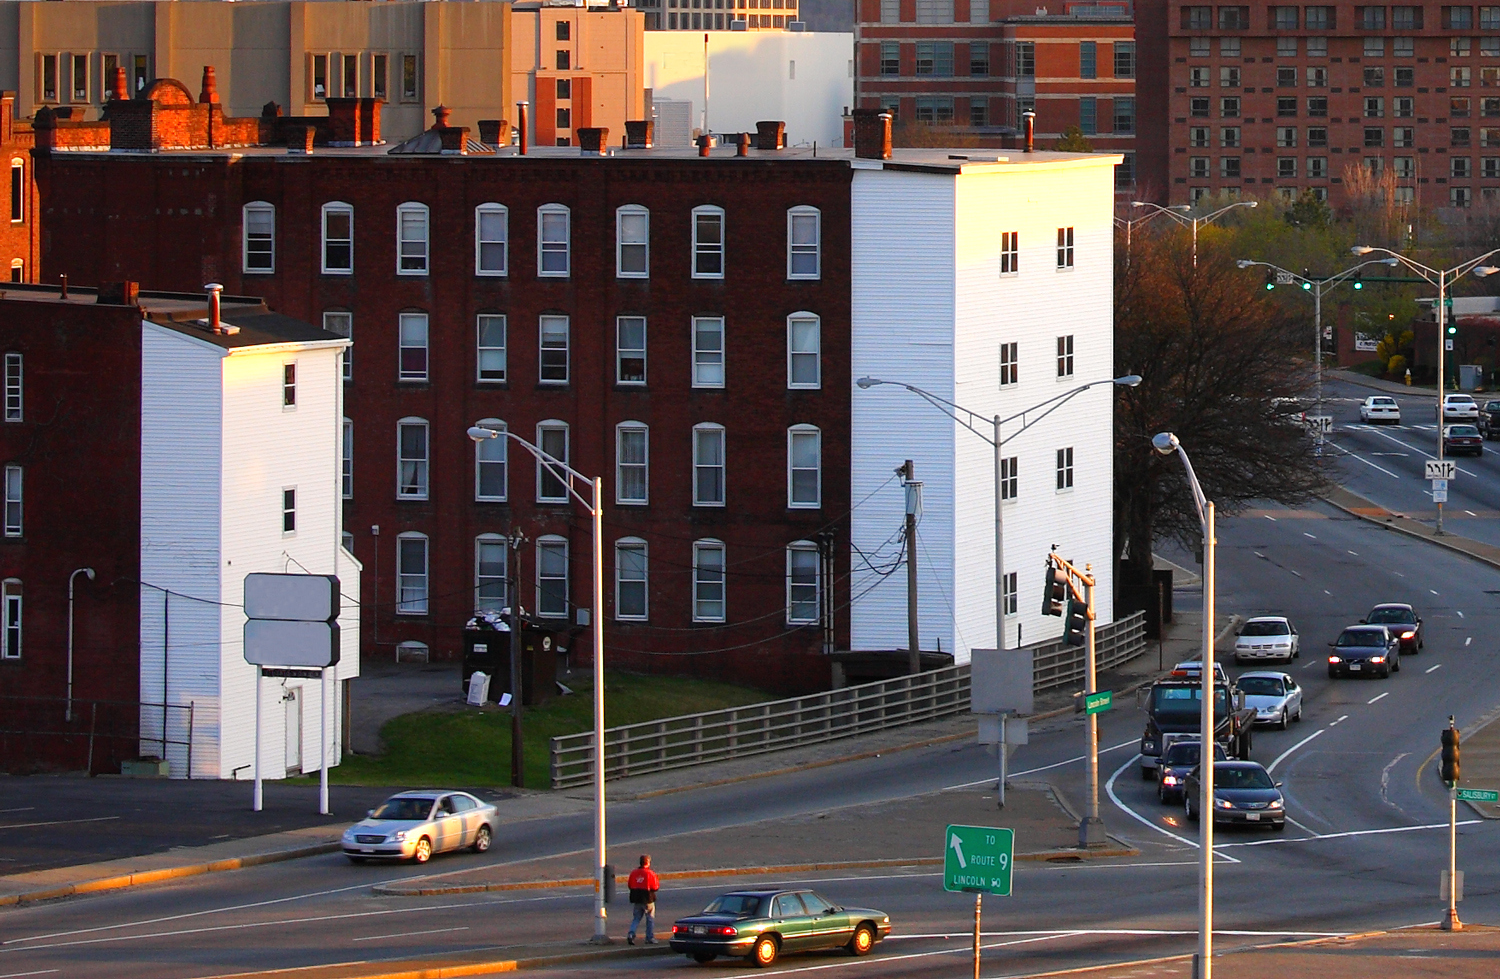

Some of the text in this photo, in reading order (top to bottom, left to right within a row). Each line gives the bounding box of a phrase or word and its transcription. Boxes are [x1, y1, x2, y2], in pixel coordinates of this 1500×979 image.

[1462, 791, 1490, 799] SALISBURY
[986, 835, 995, 845] TO
[970, 853, 1008, 870] ROUTE 9
[954, 875, 985, 886] LINCOLN
